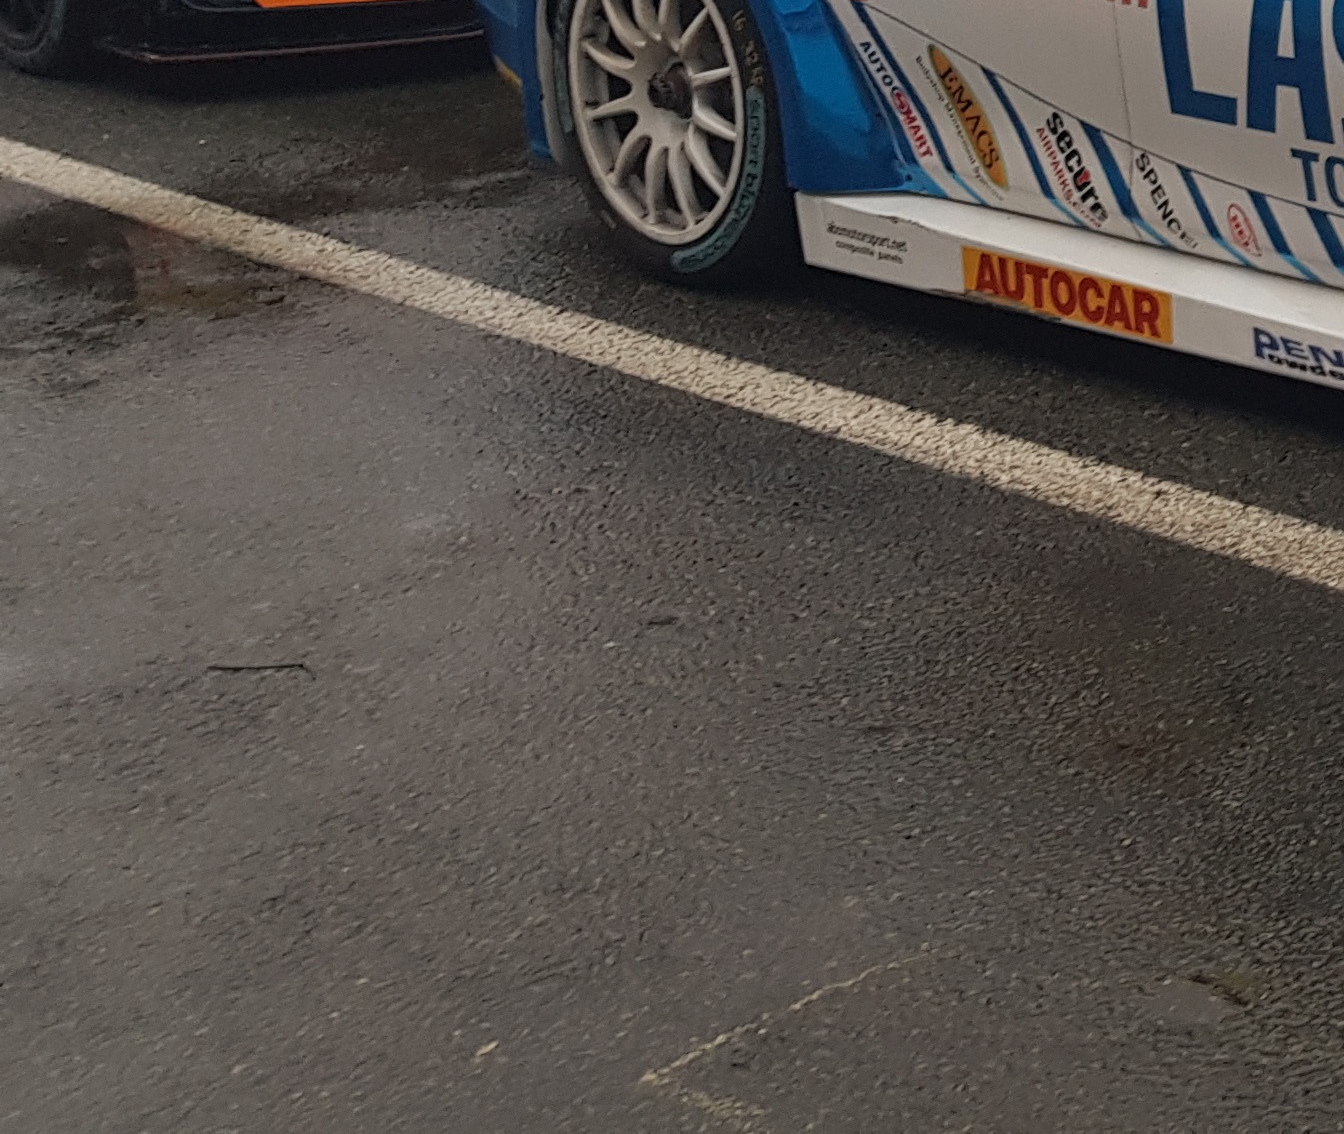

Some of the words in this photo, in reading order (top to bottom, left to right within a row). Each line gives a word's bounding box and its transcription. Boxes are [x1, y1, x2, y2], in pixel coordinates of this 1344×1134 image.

[860, 40, 934, 159] AUTOSMART
[939, 66, 1000, 170] EMACS
[1046, 110, 1109, 223] secure
[975, 251, 1163, 339] AUTOCAR
